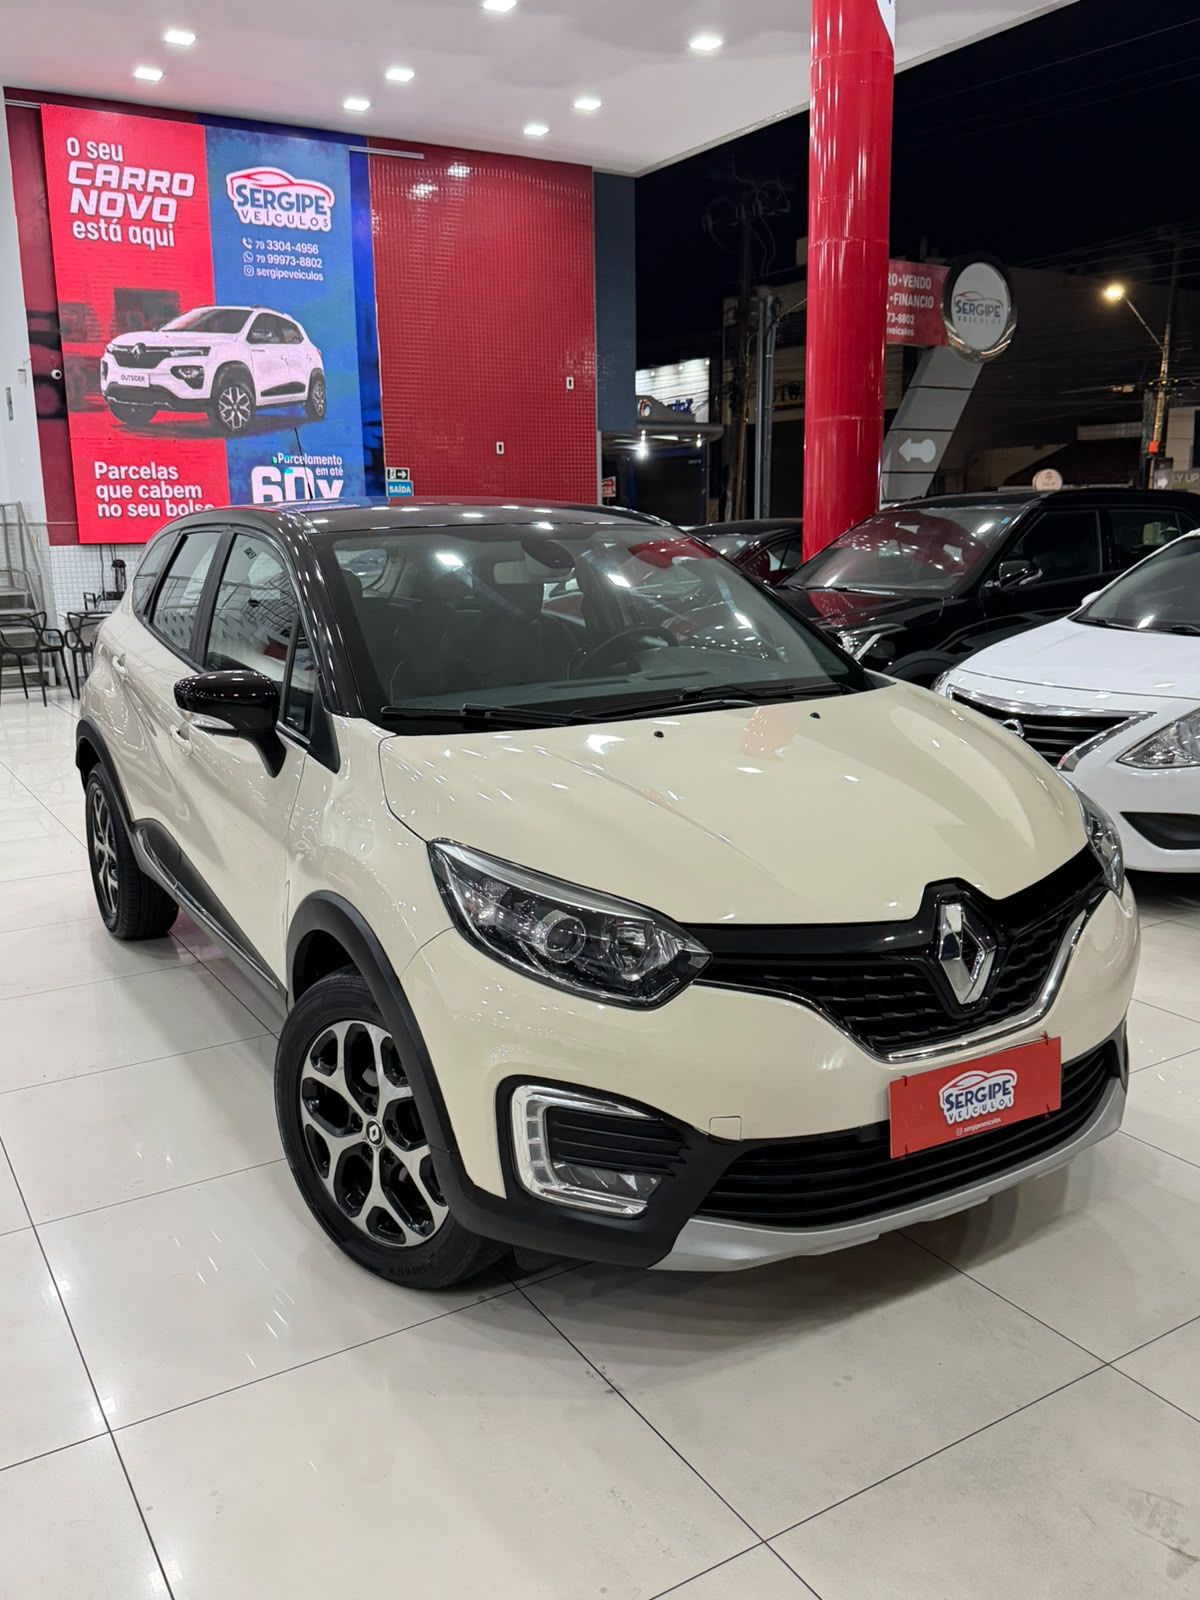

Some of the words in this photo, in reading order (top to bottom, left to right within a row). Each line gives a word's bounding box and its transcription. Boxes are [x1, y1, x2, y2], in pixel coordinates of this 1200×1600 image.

[86, 140, 124, 162] seu
[67, 160, 196, 197] CARRO
[70, 187, 178, 223] NOVO
[235, 184, 328, 216] SERGIPE
[72, 217, 123, 243] está
[128, 223, 175, 251] aqui
[255, 240, 265, 250] 79
[266, 239, 319, 255] 3304-4956
[267, 253, 323, 269] 99973-8802
[903, 274, 932, 290] VENDO
[893, 292, 934, 309] FINANCIO
[956, 299, 1001, 318] SERGIPE
[277, 452, 343, 466] Parcelamento
[94, 461, 179, 480] Parcelas
[315, 467, 329, 477] em
[330, 466, 344, 477] até
[96, 484, 133, 502] que
[138, 480, 203, 499] cabem
[97, 503, 122, 517] no
[127, 503, 161, 517] seu
[945, 1079, 1012, 1113] SERGIPE
